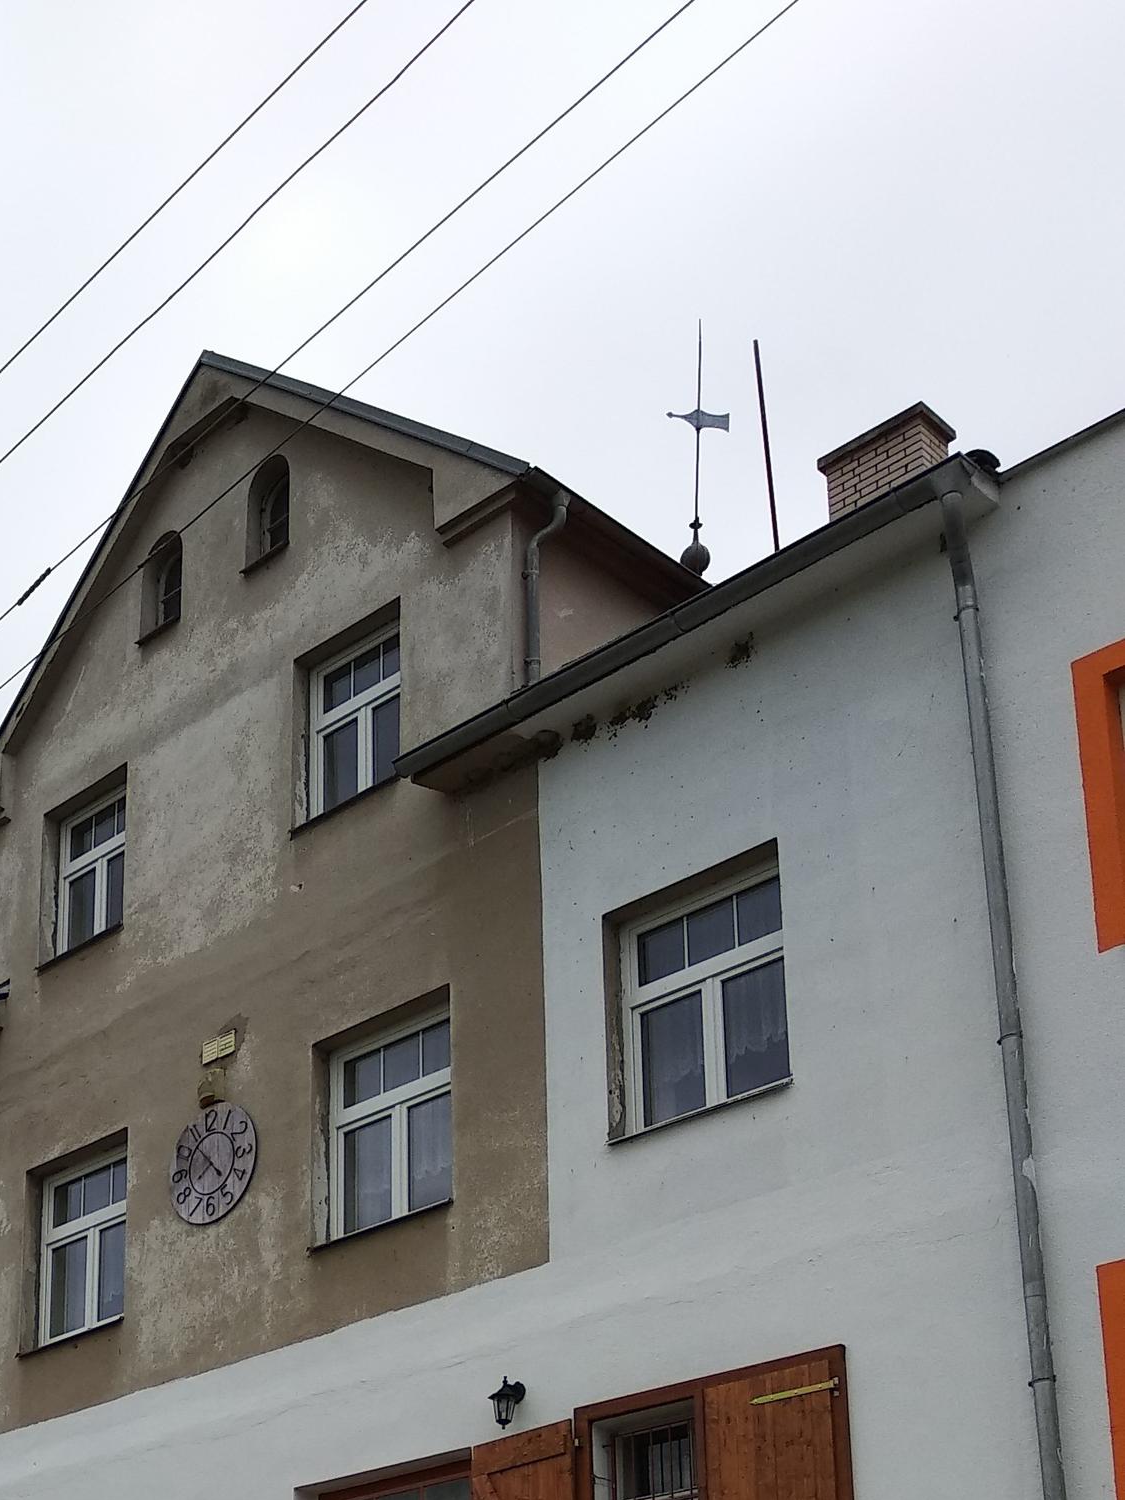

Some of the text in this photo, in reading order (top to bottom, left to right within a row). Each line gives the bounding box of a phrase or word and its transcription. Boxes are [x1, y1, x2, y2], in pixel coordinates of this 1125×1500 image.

[204, 1109, 218, 1133] 12
[222, 1109, 232, 1131] 1
[189, 1124, 202, 1143] 11
[230, 1120, 248, 1142] 2
[177, 1144, 193, 1162] 10
[235, 1143, 253, 1159] 3
[172, 1168, 188, 1184] 9
[233, 1167, 246, 1182] 4
[176, 1186, 192, 1205] 8
[220, 1183, 234, 1205] 5
[189, 1196, 203, 1217] 7
[205, 1195, 216, 1217] 6
